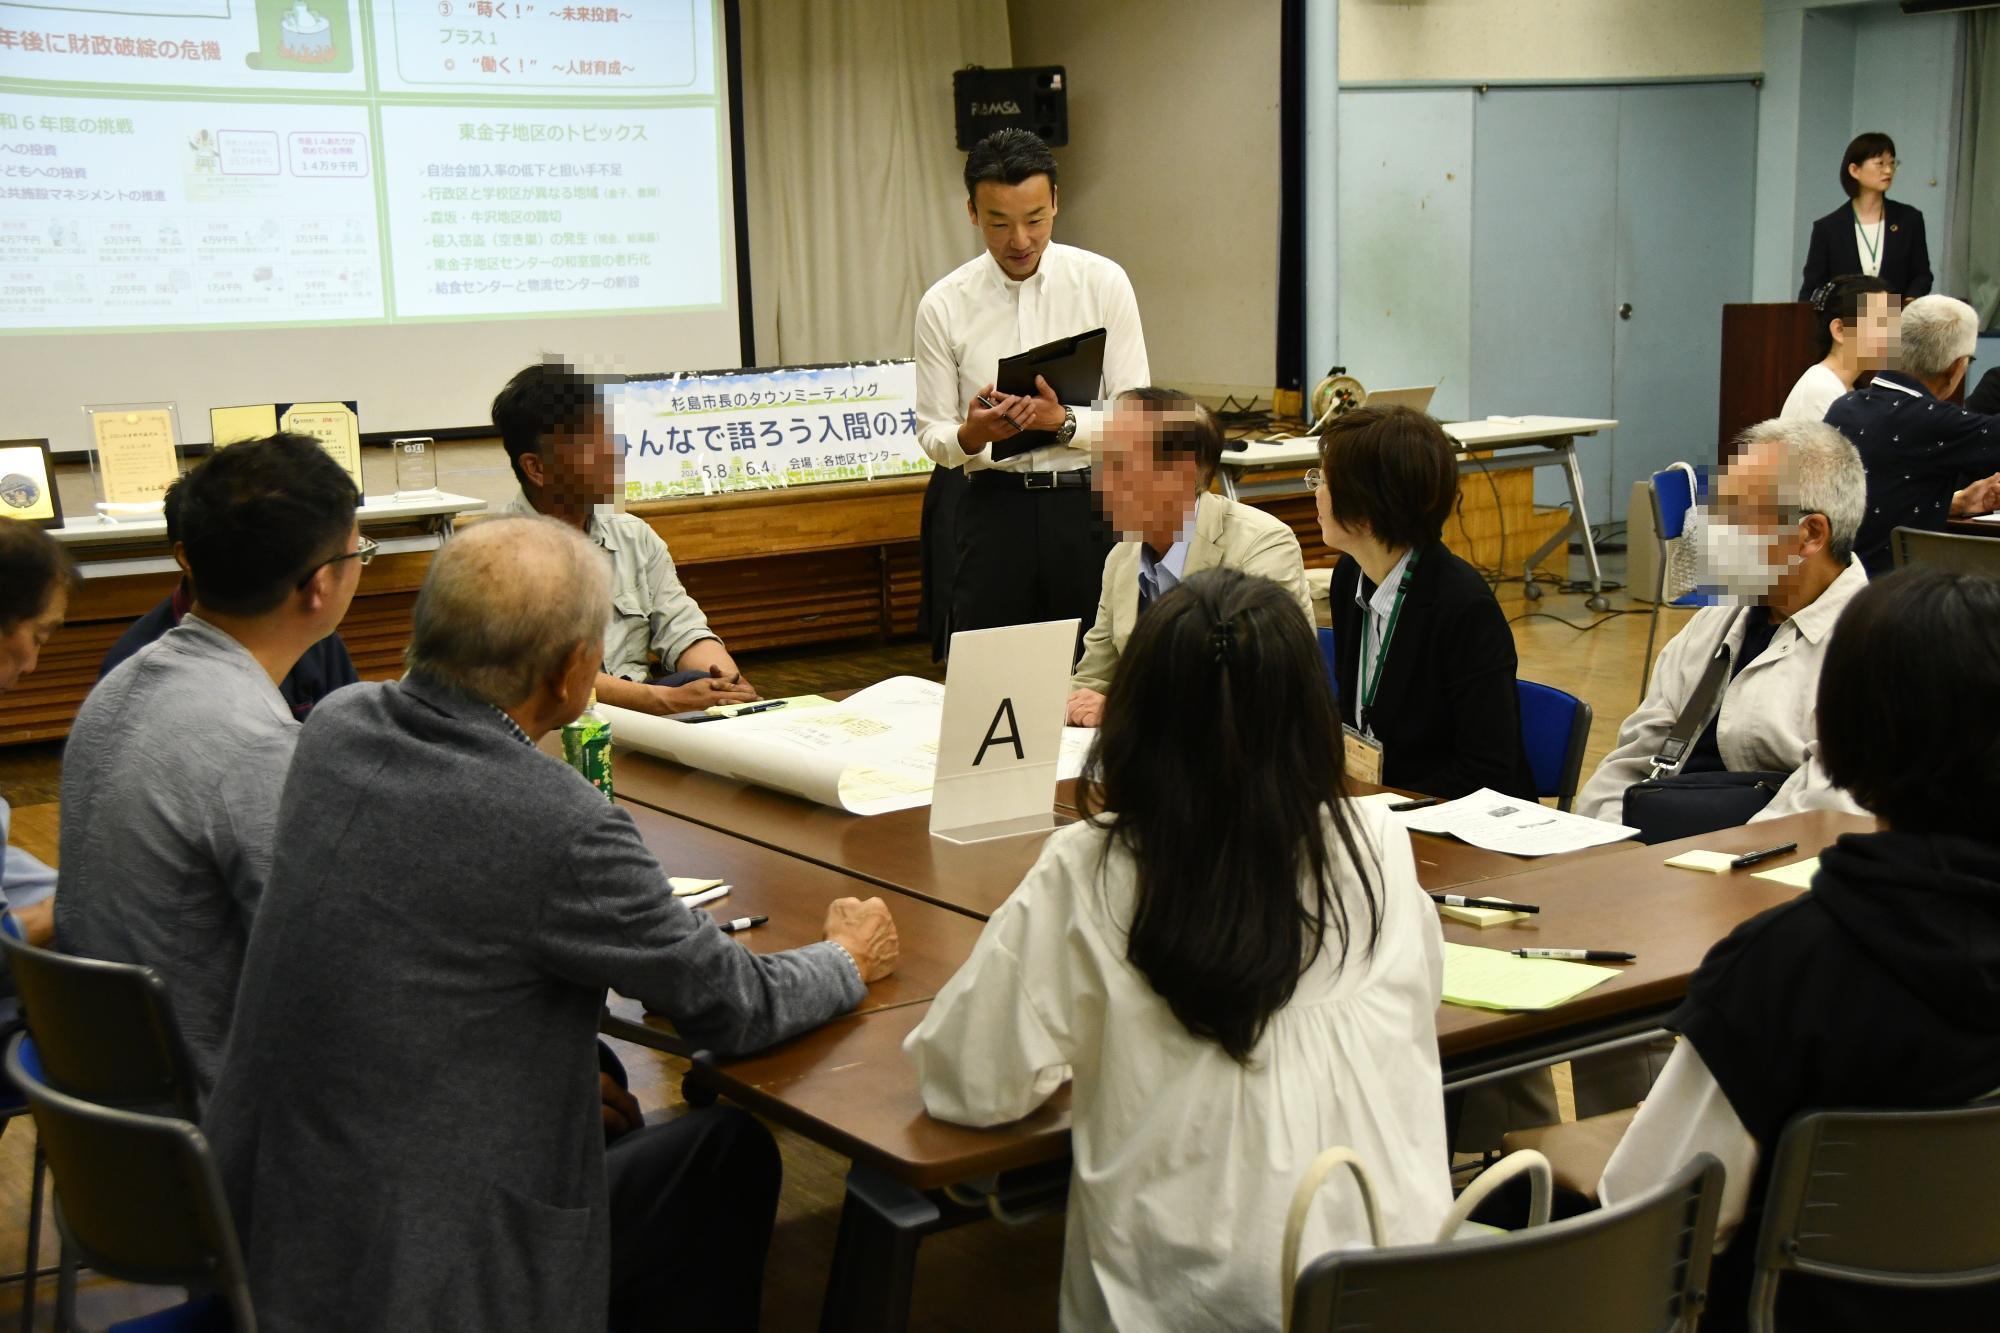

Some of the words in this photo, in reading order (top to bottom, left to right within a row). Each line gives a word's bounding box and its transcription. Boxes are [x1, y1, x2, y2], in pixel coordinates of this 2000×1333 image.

[458, 123, 648, 143] 東金子地区のトピックス
[671, 382, 879, 412] 杉島市長のタウンミーティング
[625, 408, 916, 458] んなで語ろう入間の未
[972, 697, 1025, 767] A
